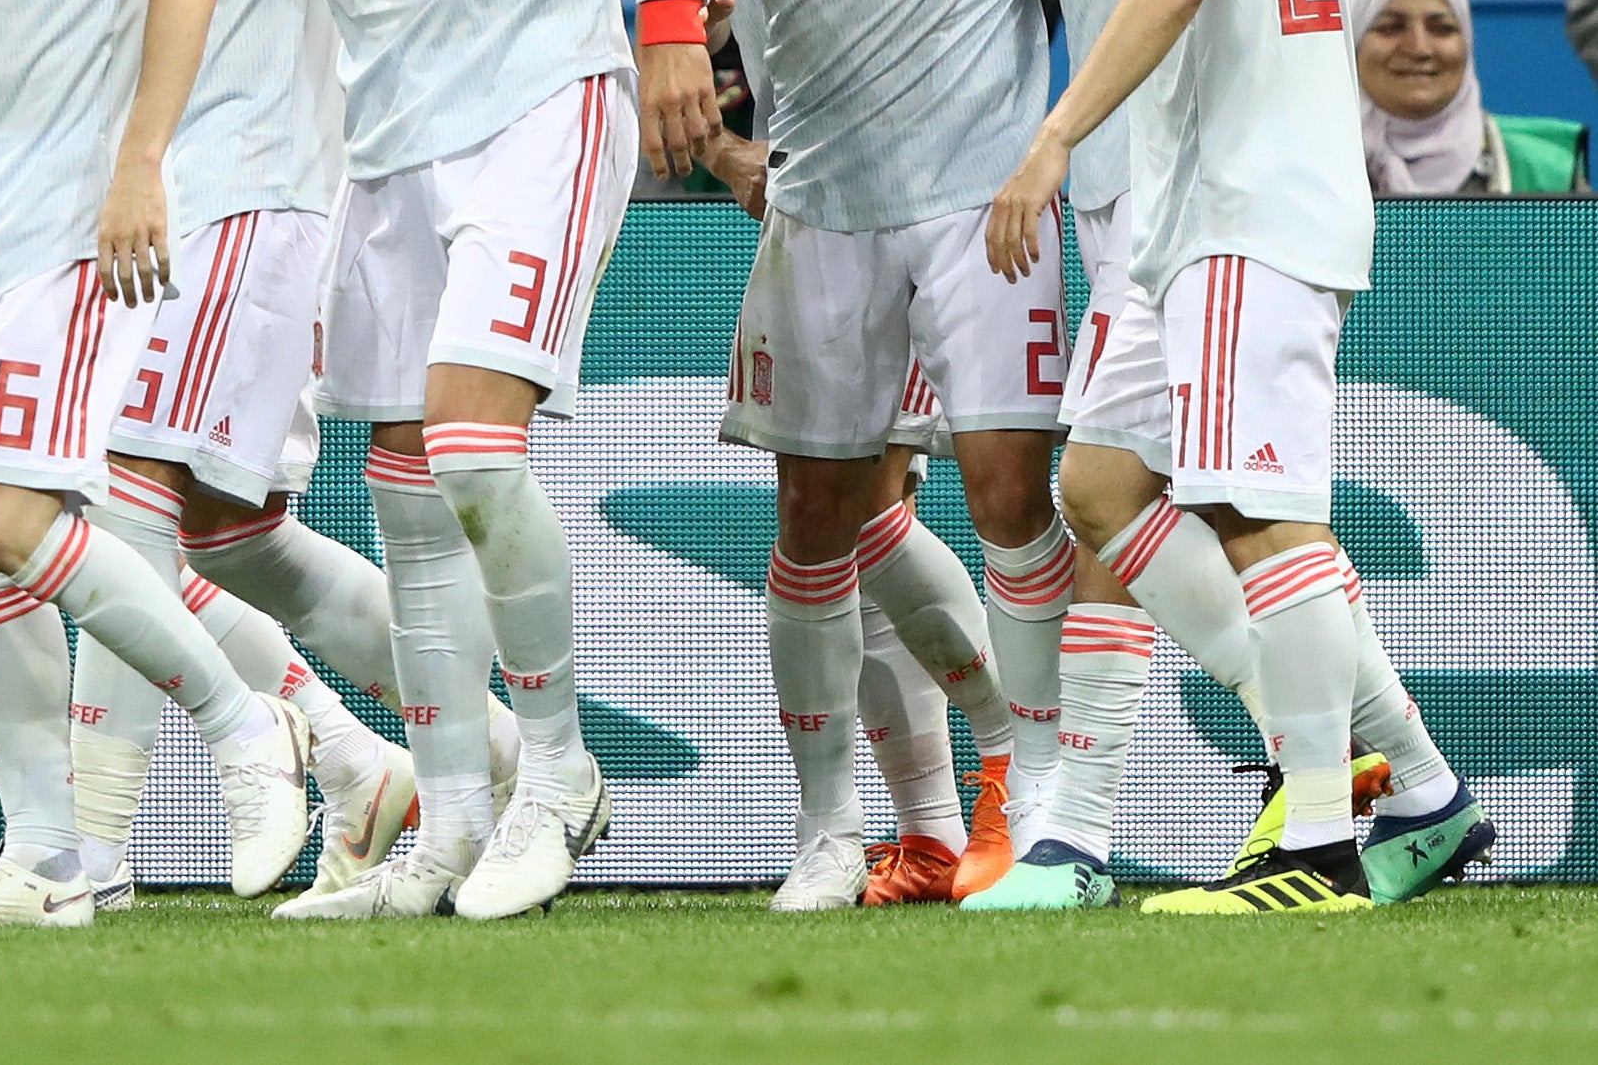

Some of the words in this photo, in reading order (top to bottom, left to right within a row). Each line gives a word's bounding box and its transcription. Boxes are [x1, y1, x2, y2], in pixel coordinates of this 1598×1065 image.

[489, 249, 548, 344] 3
[1027, 309, 1064, 395] 2
[1243, 459, 1284, 474] adidas
[71, 703, 108, 725] FEF
[403, 704, 441, 725] FEF
